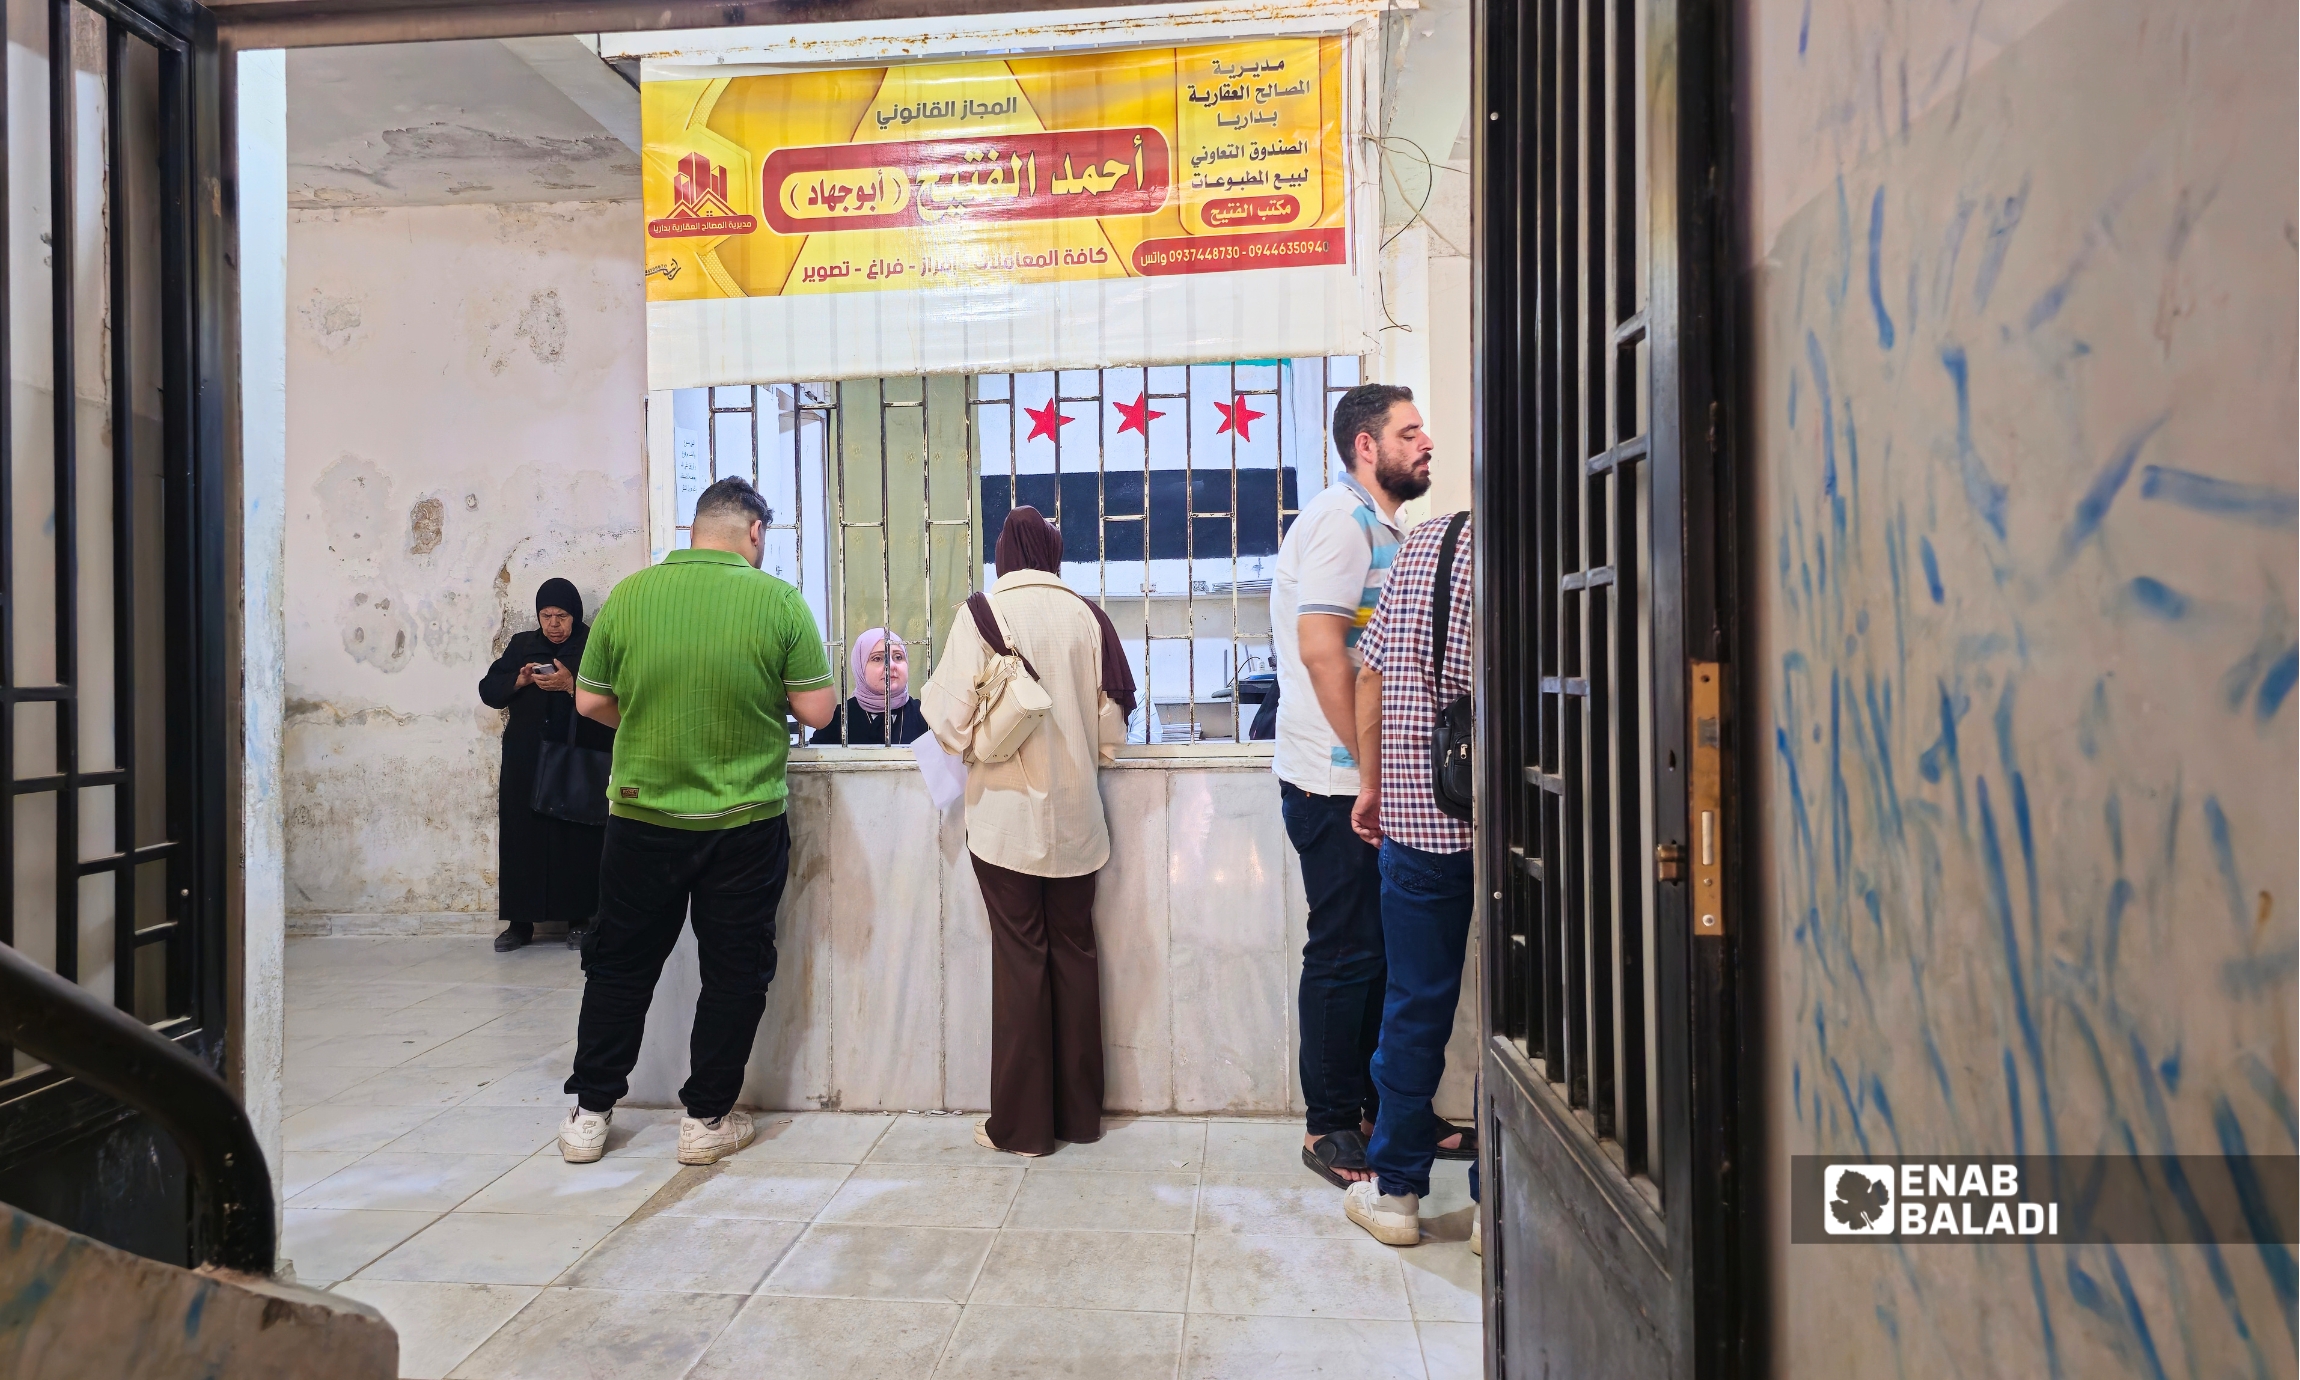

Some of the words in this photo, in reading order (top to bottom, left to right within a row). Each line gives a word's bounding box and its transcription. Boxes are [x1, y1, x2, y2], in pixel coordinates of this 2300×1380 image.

[1212, 59, 1285, 79] مديرية
[1187, 83, 1250, 107] العقارية
[1255, 80, 1310, 105] المصالح
[876, 101, 956, 130] القانوني
[960, 97, 1017, 120] المجاز
[1217, 110, 1278, 130] بداريا
[1191, 143, 1245, 168] التعاوني
[1249, 139, 1308, 161] الصندوق
[1051, 134, 1144, 196] أحمد
[915, 149, 1037, 222] الفتيح
[1191, 169, 1269, 191] المطبوعات
[1273, 167, 1309, 190] لبيع
[1210, 202, 1253, 225] الفتيح
[1257, 199, 1291, 221] مكتب
[653, 225, 671, 233] بداريا
[672, 223, 700, 232] العقارية
[702, 222, 727, 232] المصالح
[728, 221, 752, 230] مديرية
[1064, 247, 1108, 266] كافة
[1140, 251, 1167, 267] واتس
[1169, 246, 1240, 263] 0937448730
[802, 260, 850, 283] تصوير
[867, 258, 904, 280] فراغ
